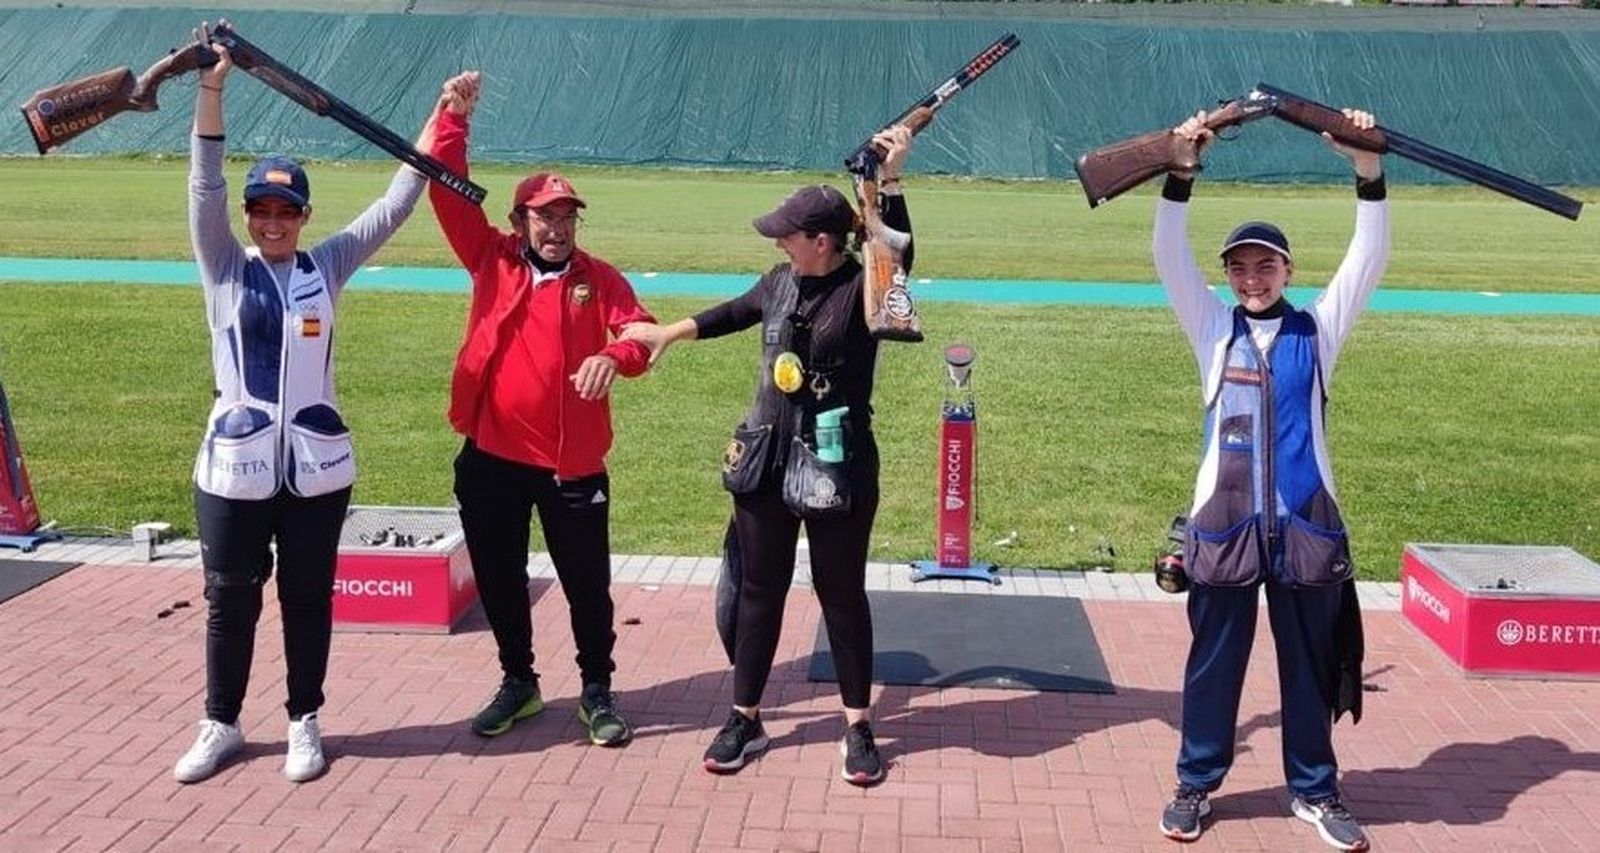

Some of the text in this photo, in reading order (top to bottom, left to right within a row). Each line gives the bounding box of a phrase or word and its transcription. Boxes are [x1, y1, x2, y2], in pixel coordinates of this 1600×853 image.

[948, 439, 962, 496] FIOCCHI
[333, 579, 413, 597] FIOCCHI
[1525, 624, 1600, 644] BERETT
